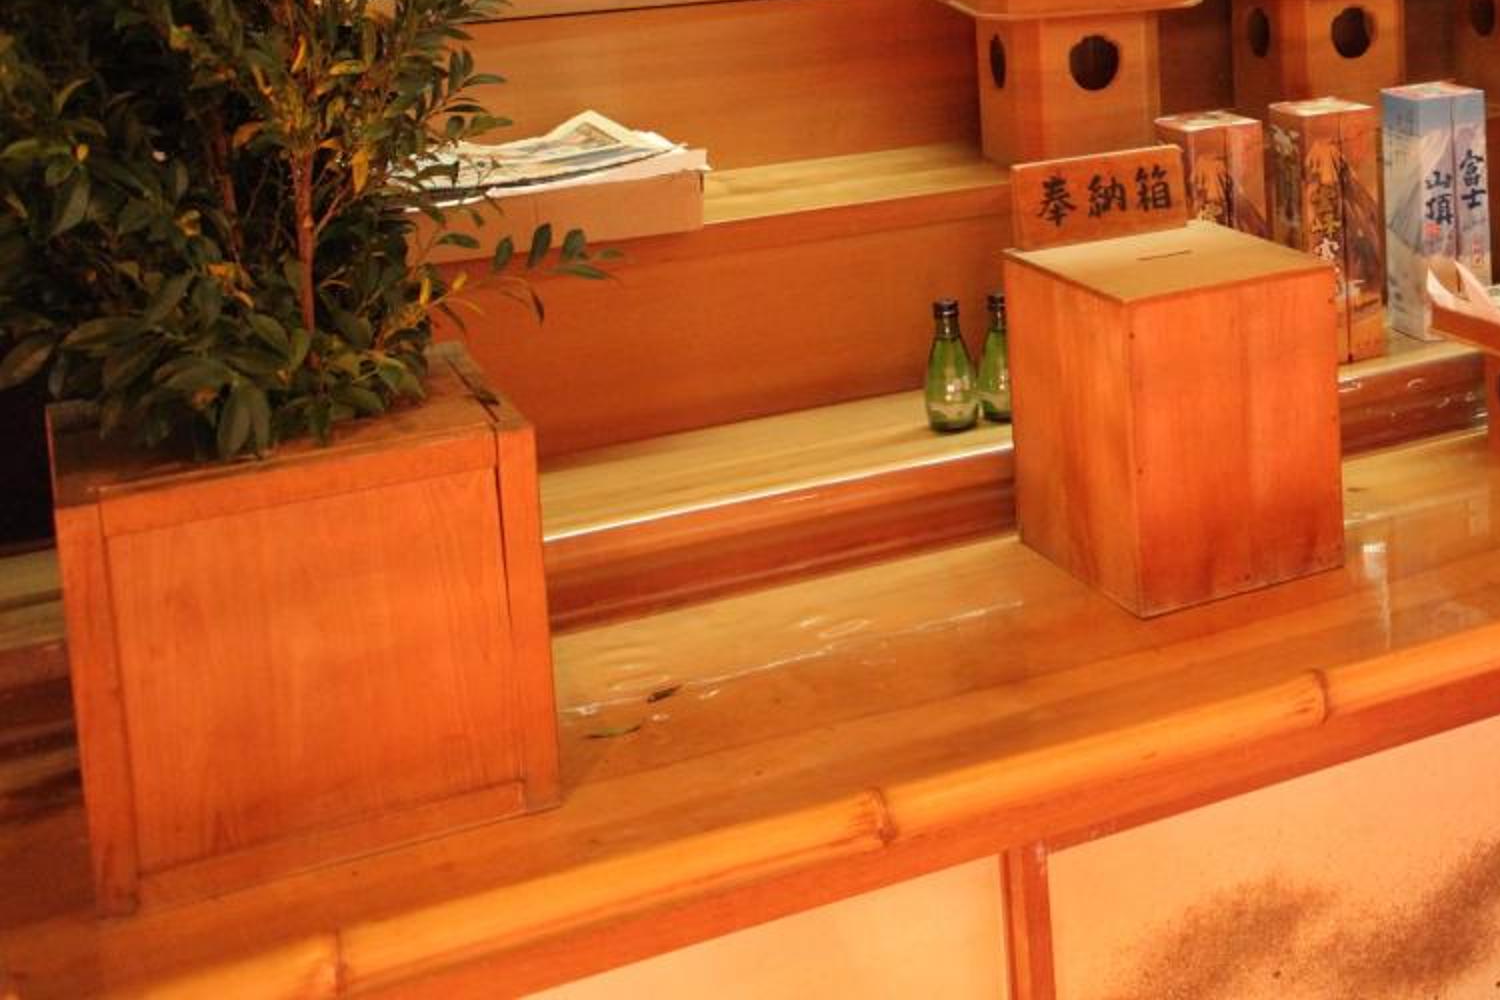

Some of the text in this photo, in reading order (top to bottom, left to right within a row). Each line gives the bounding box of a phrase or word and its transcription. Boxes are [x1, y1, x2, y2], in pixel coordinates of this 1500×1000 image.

[1037, 164, 1173, 227] 奉納箱
[1424, 170, 1453, 226] 山頂
[1460, 149, 1487, 210] 富士
